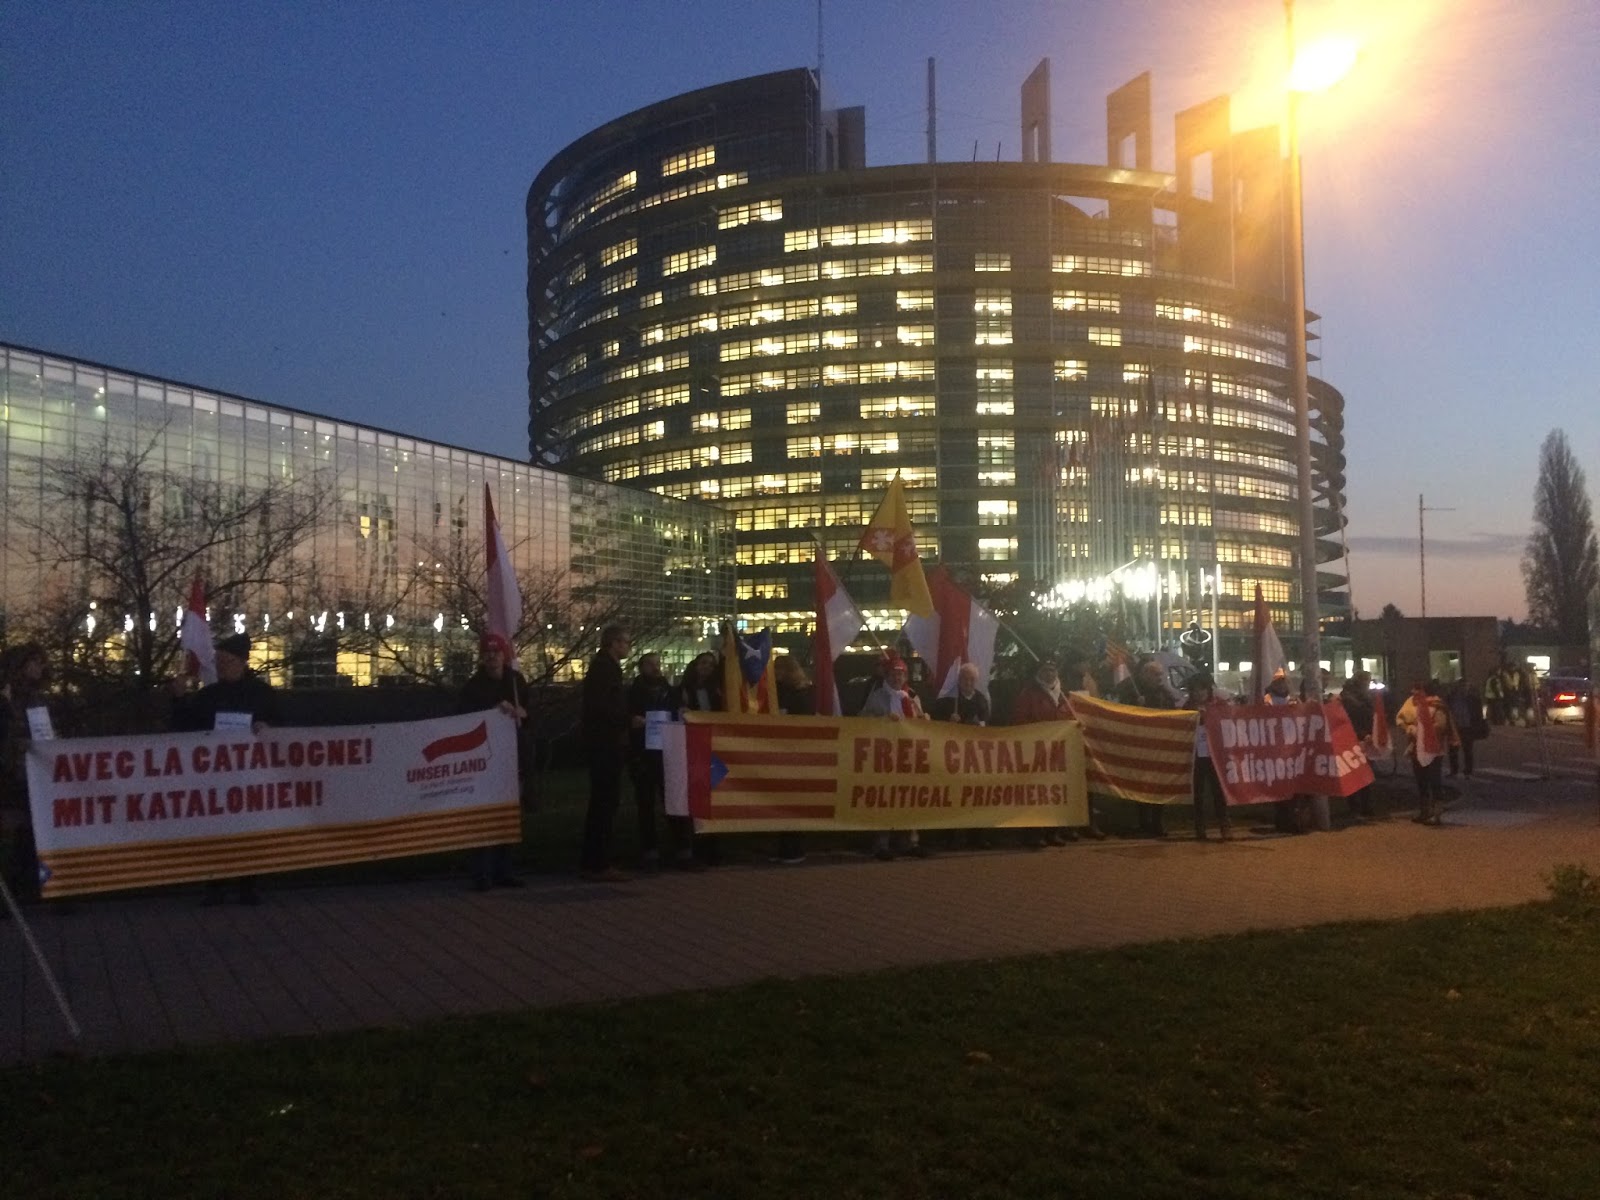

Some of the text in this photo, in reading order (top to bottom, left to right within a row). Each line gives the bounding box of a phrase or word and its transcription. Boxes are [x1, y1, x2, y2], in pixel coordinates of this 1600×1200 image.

[1220, 718, 1277, 748] DROIT
[53, 738, 372, 782] AVEC LA CATALOGNE!
[406, 758, 487, 783] UNSER LAND
[853, 737, 1066, 775] FREE CATALAN
[53, 780, 323, 828] MIT KATALONIEN!
[850, 783, 1069, 809] POLITICAL PRISONERS!
